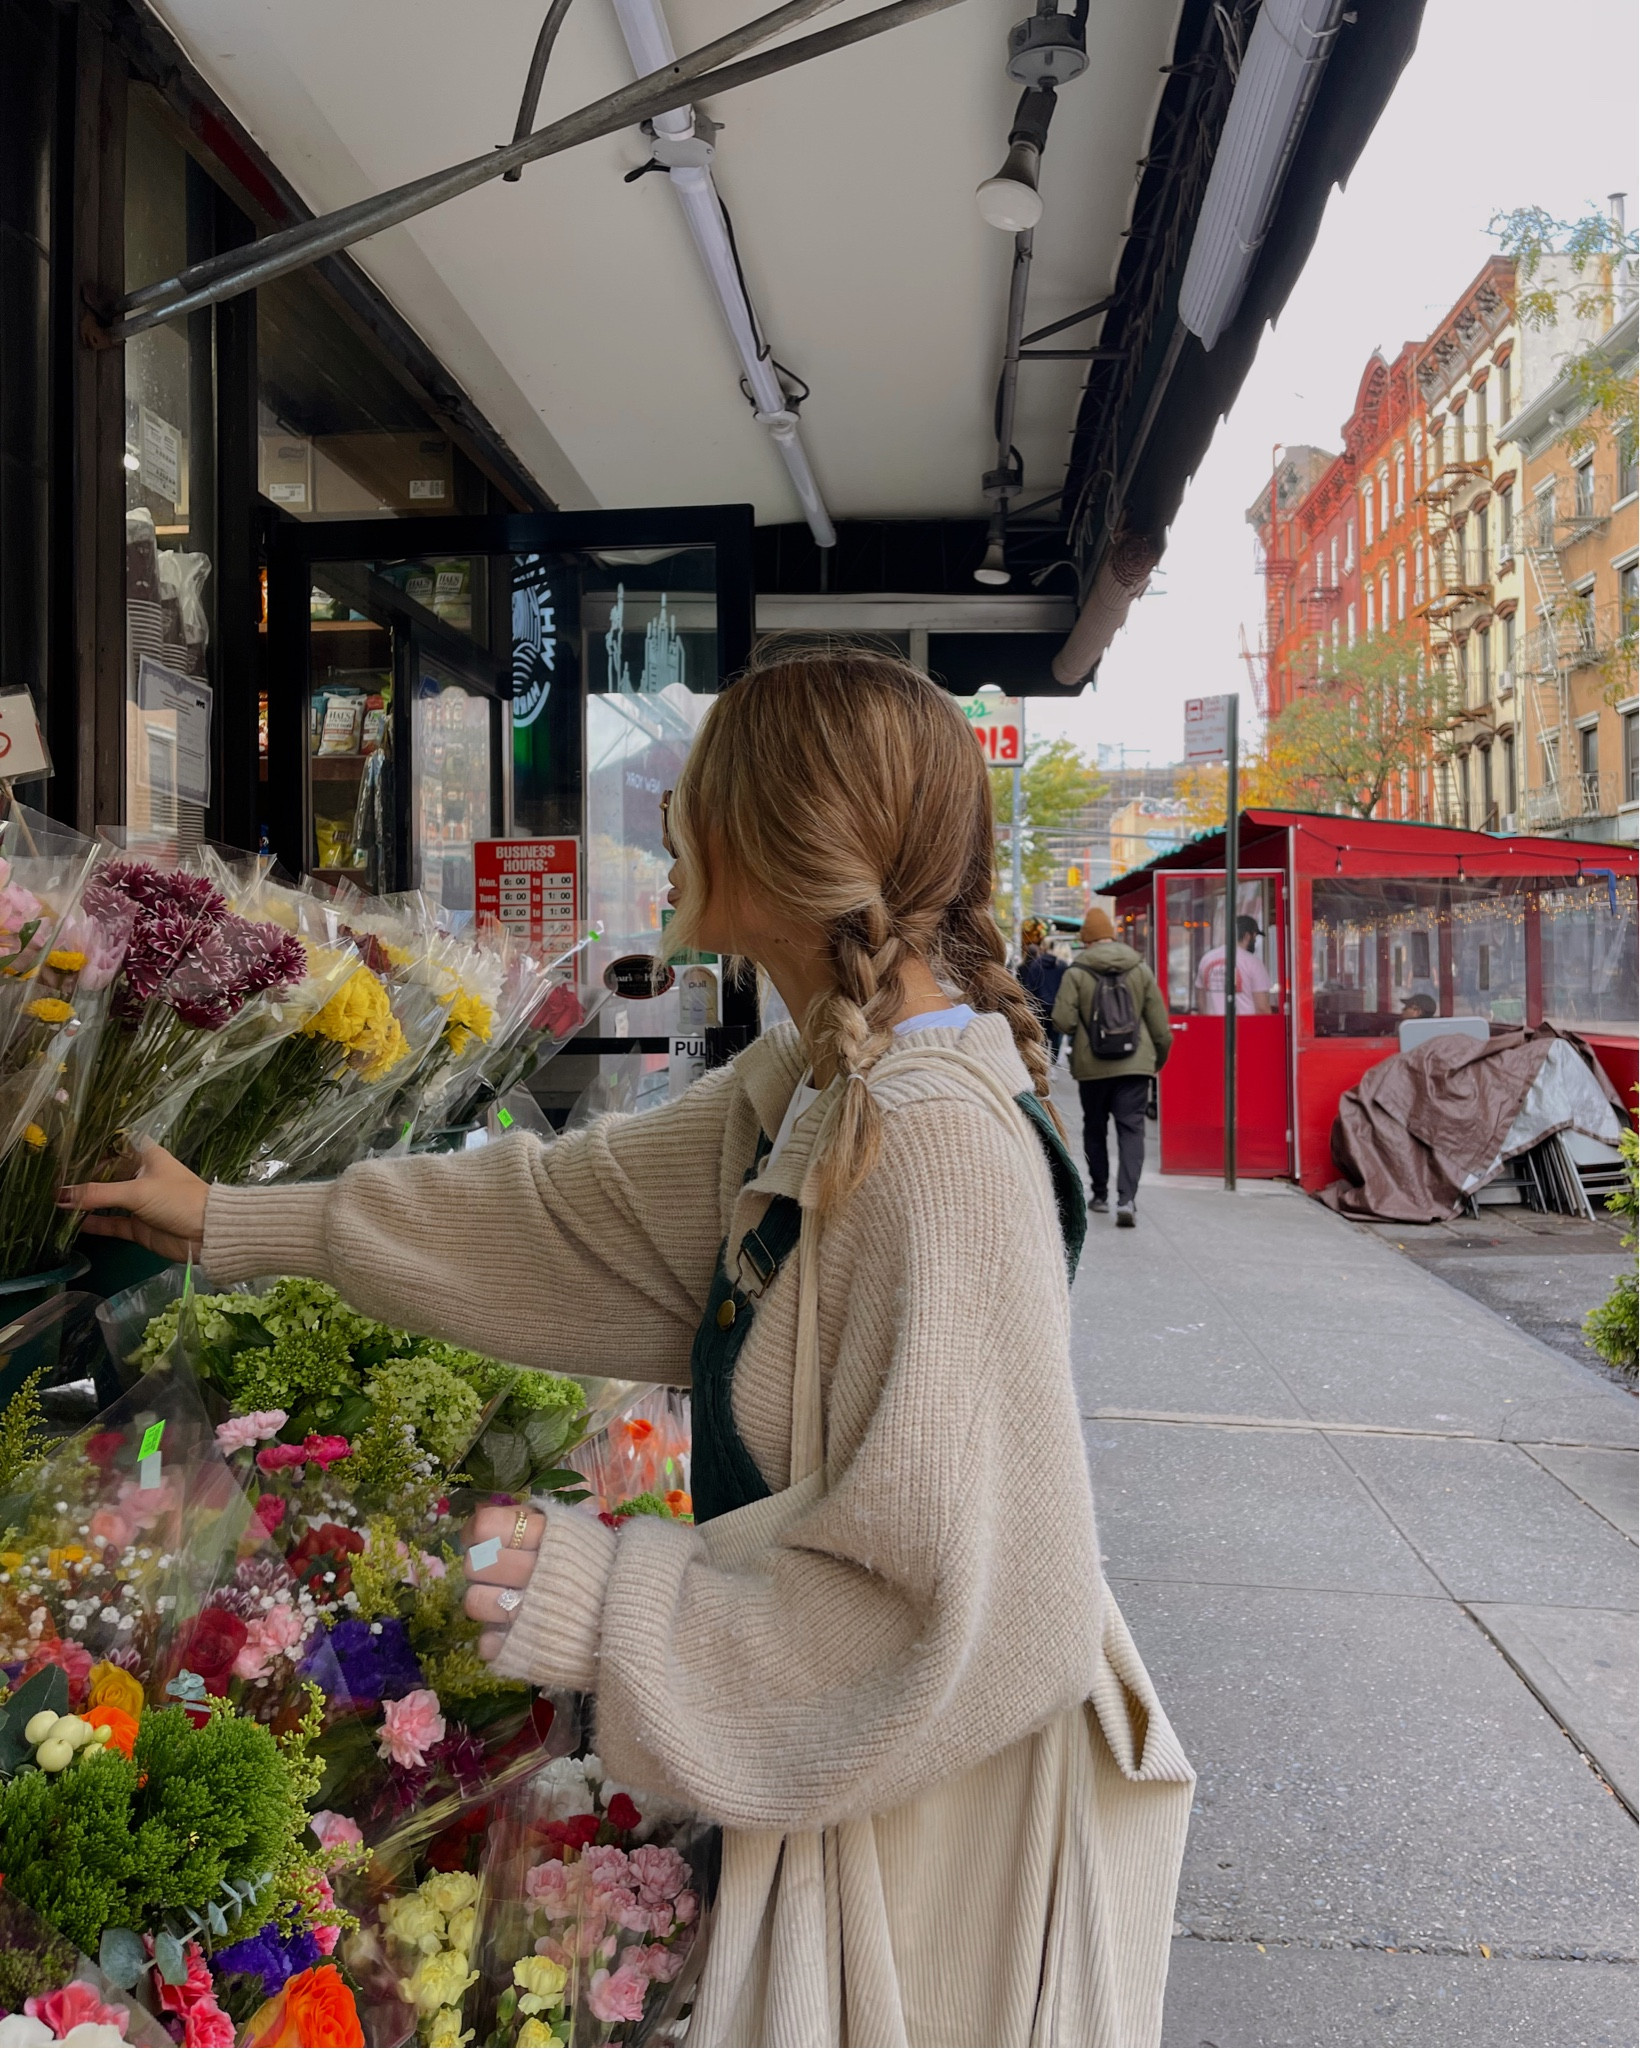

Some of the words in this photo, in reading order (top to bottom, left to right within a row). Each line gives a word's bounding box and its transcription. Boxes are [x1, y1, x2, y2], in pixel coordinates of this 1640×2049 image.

[495, 844, 556, 859] BUSINESS
[503, 858, 549, 873] HOURS:
[479, 878, 498, 887] Mon.
[532, 877, 541, 887] to
[532, 893, 541, 902] to
[532, 908, 541, 918] to
[688, 980, 707, 989] pull
[675, 1041, 707, 1056] PUL
